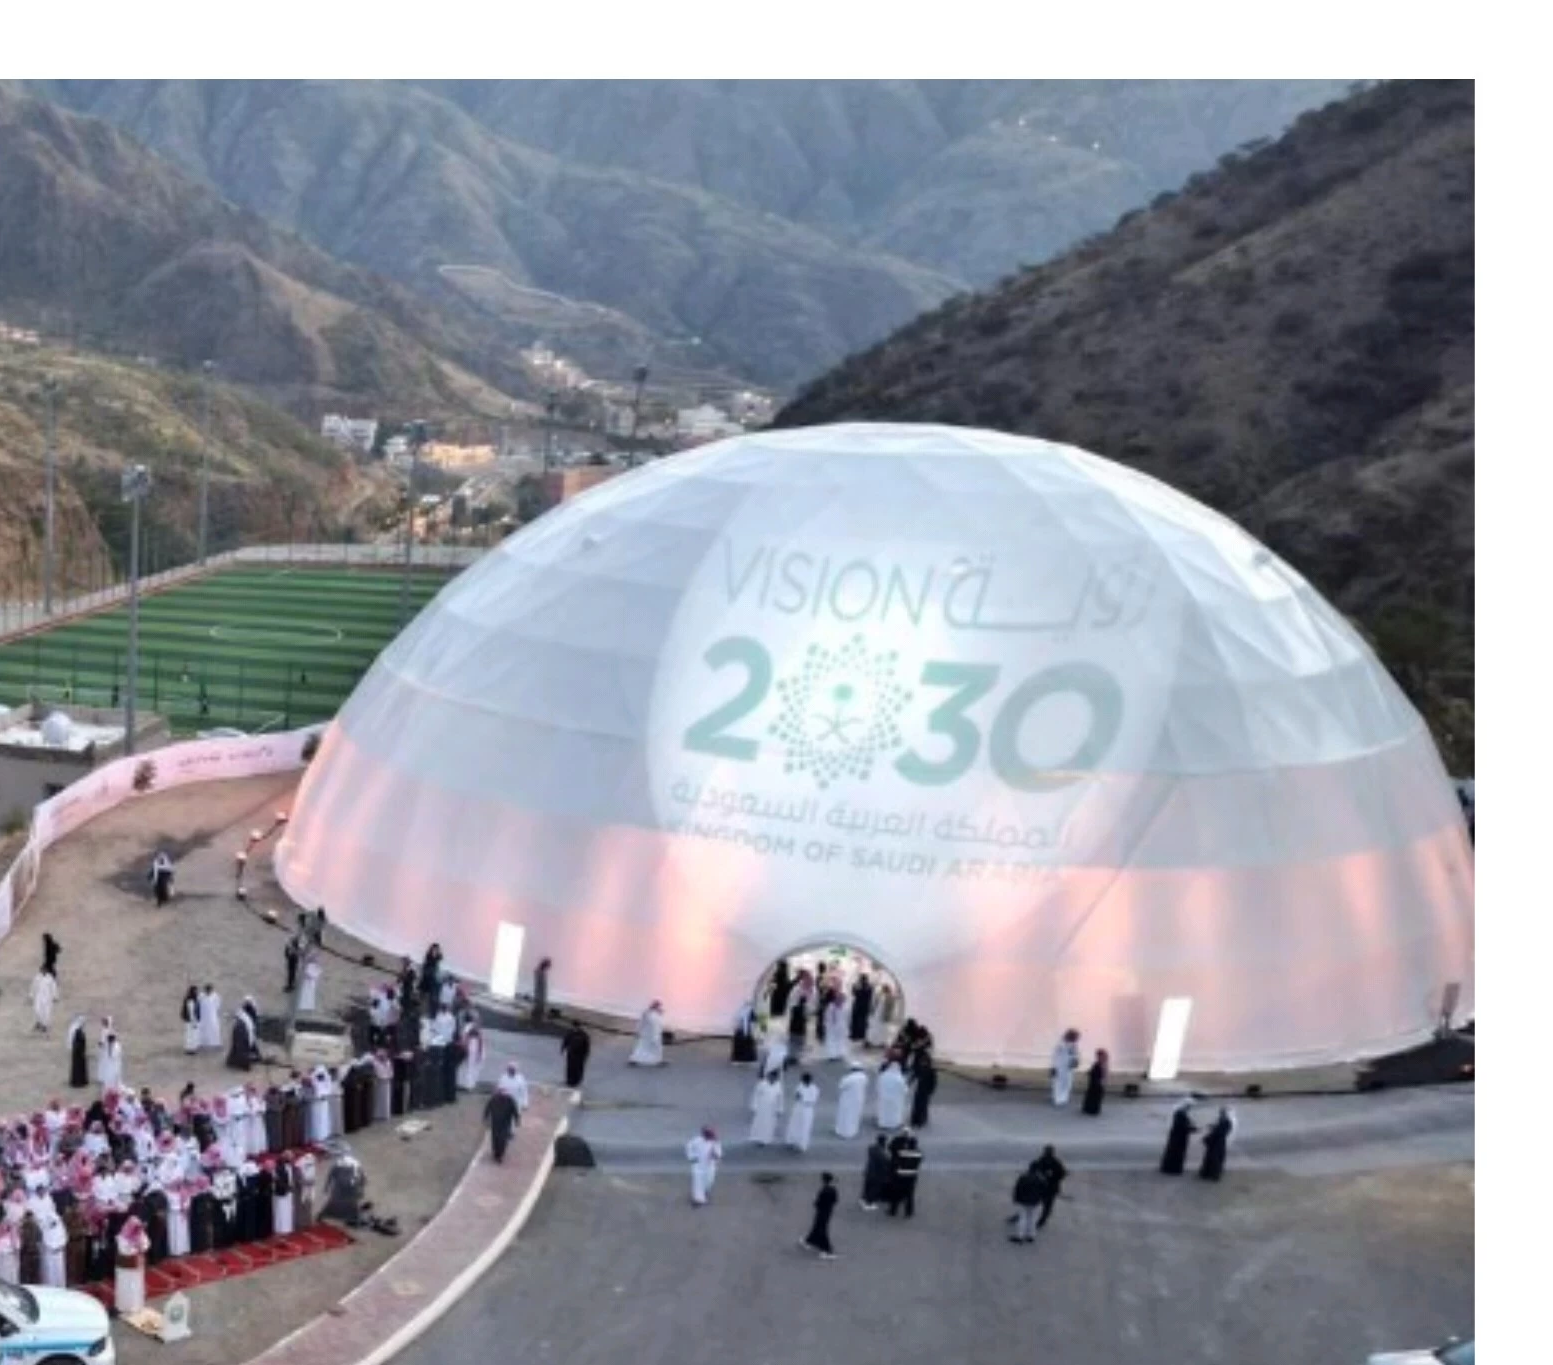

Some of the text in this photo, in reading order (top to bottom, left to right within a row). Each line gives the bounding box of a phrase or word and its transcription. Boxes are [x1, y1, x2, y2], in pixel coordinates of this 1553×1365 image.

[719, 536, 937, 630] VISION
[669, 776, 820, 824] السعودية
[824, 797, 926, 836] العربية
[803, 840, 843, 863] OF
[849, 846, 937, 877] SAUDI
